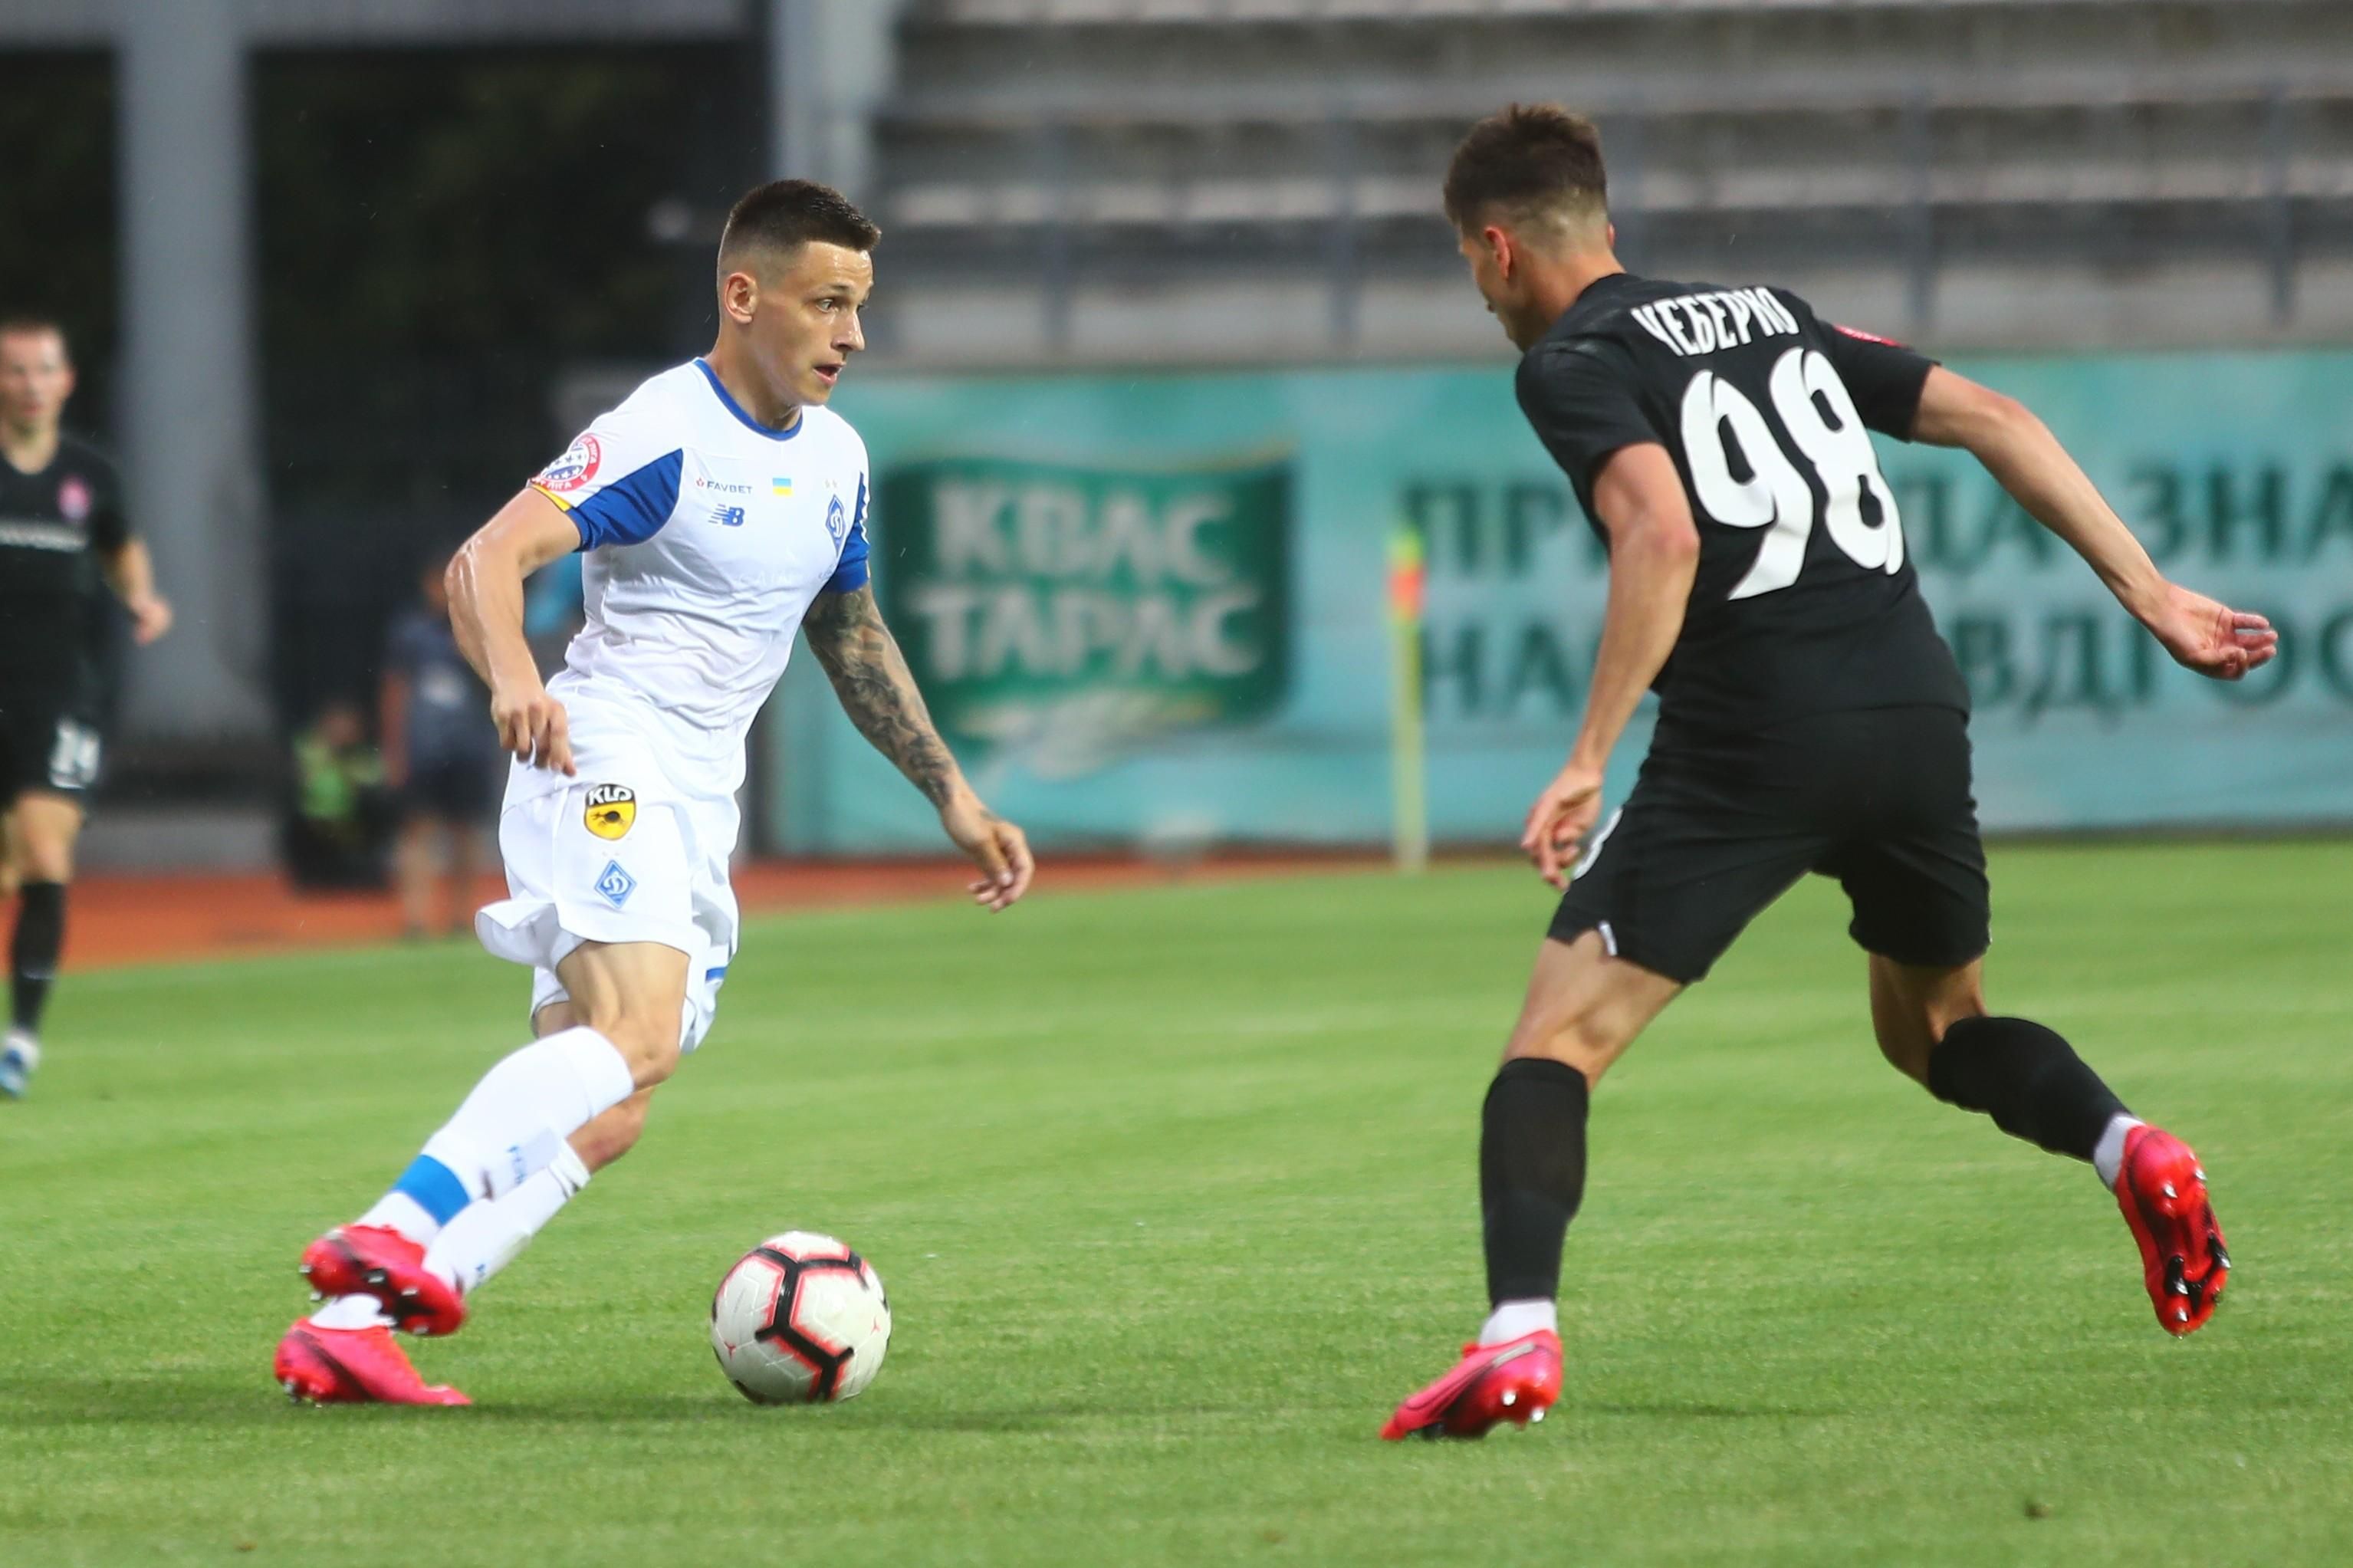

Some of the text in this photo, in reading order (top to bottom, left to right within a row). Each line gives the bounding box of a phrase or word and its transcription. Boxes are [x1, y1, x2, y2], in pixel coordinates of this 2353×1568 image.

[707, 480, 753, 495] FAVBET
[1681, 346, 1904, 601] 98
[932, 477, 1236, 587] КВАС
[905, 580, 1262, 681] ТАРАС
